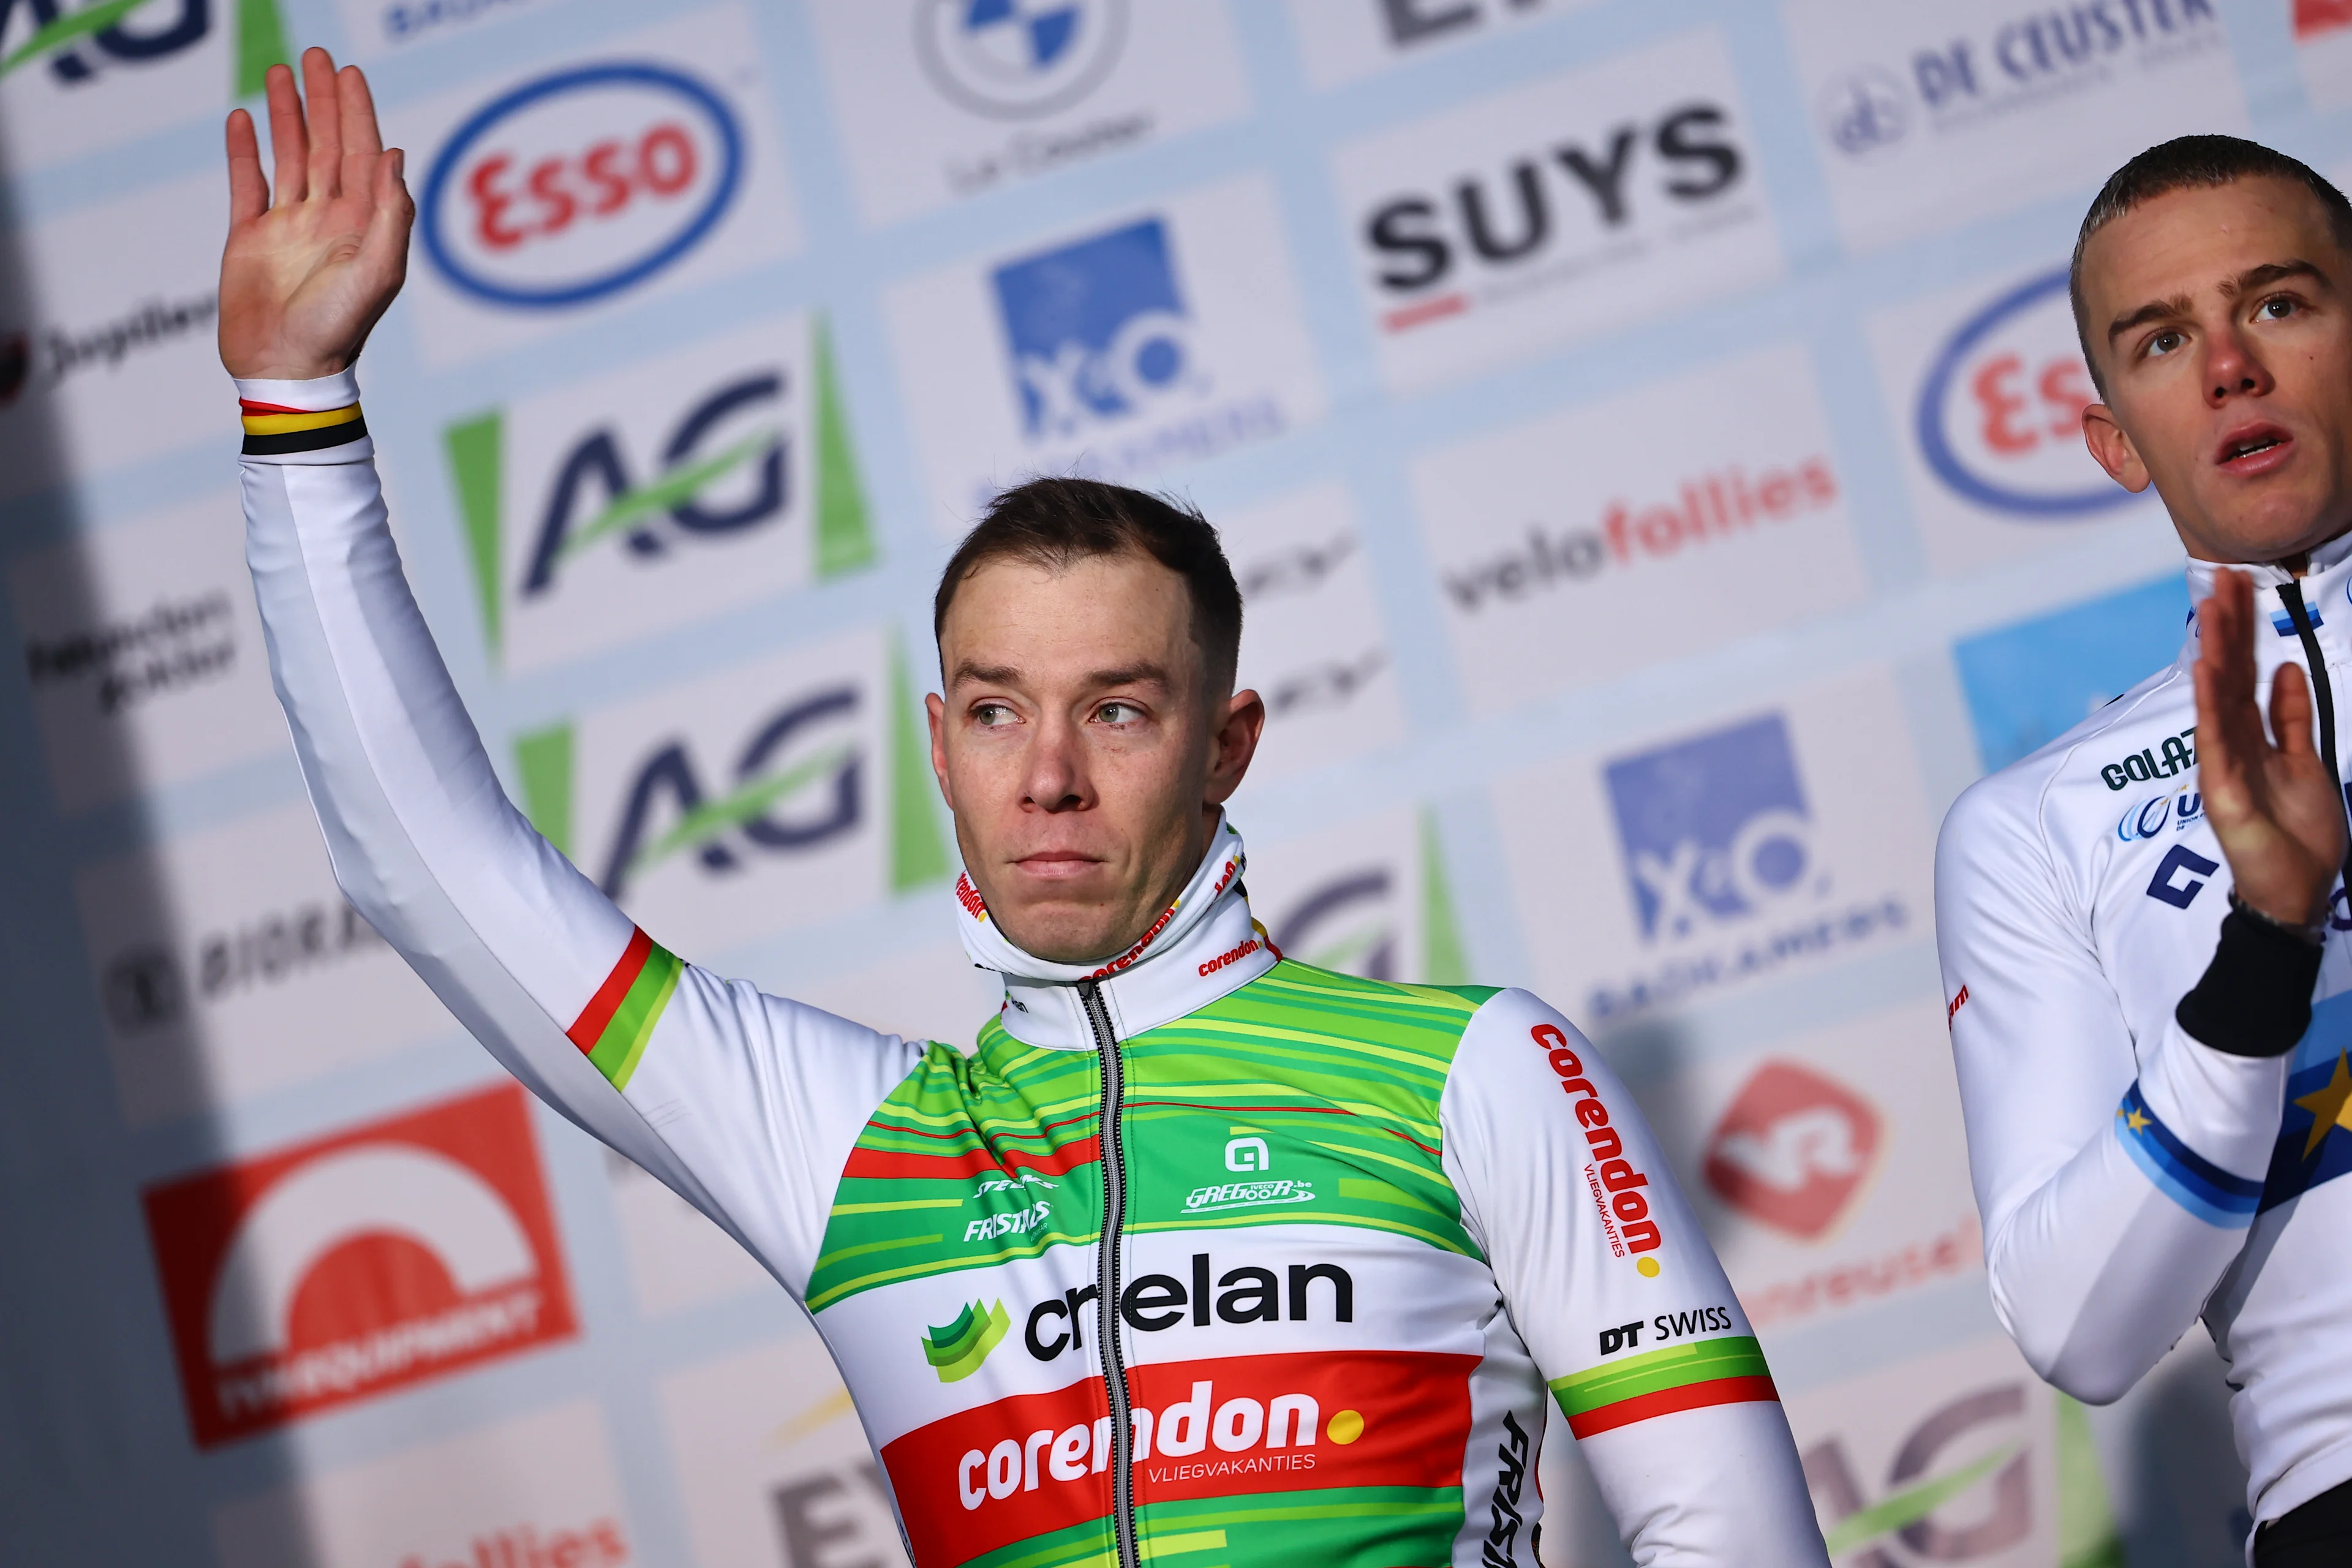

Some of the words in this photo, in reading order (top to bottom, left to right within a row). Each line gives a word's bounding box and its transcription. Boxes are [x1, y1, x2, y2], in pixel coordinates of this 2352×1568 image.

[1363, 101, 1743, 295] SUYS
[521, 366, 786, 602] AG
[1442, 454, 1839, 615] velofollies
[2177, 815, 2198, 826] UNION
[1198, 939, 1259, 977] corendon
[1531, 1023, 1662, 1254] corendon
[1583, 1163, 1626, 1259] VLIEGVAKANTIES
[1025, 1253, 1353, 1362] crelan
[1599, 1321, 1644, 1355] DT
[1654, 1306, 1732, 1341] SWISS
[959, 1380, 1320, 1511] corendon
[1148, 1453, 1316, 1483] VLIEGVAKANTIES
